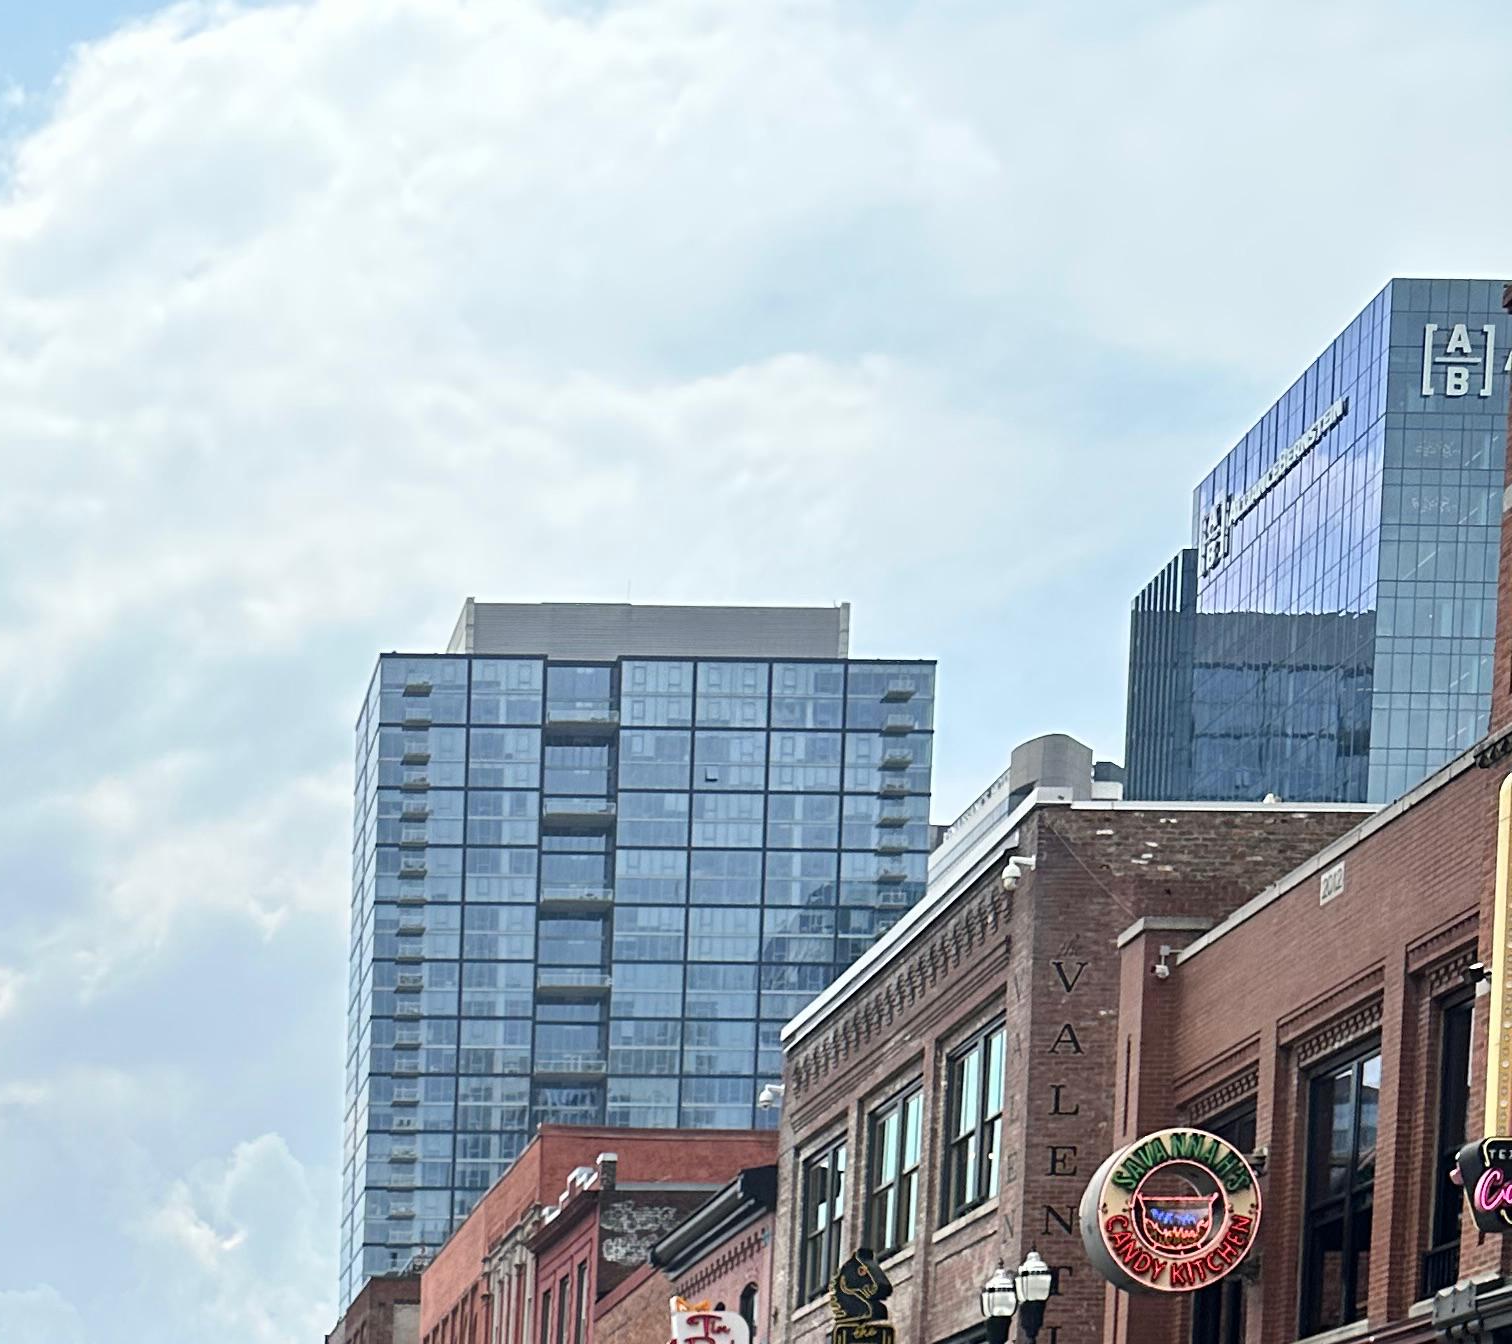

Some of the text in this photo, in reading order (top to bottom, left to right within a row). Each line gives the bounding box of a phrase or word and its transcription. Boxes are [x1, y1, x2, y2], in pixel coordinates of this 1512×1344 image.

[1111, 1131, 1253, 1193] SAVANNAH'S
[1106, 1214, 1254, 1288] CANDY KITCHEN
